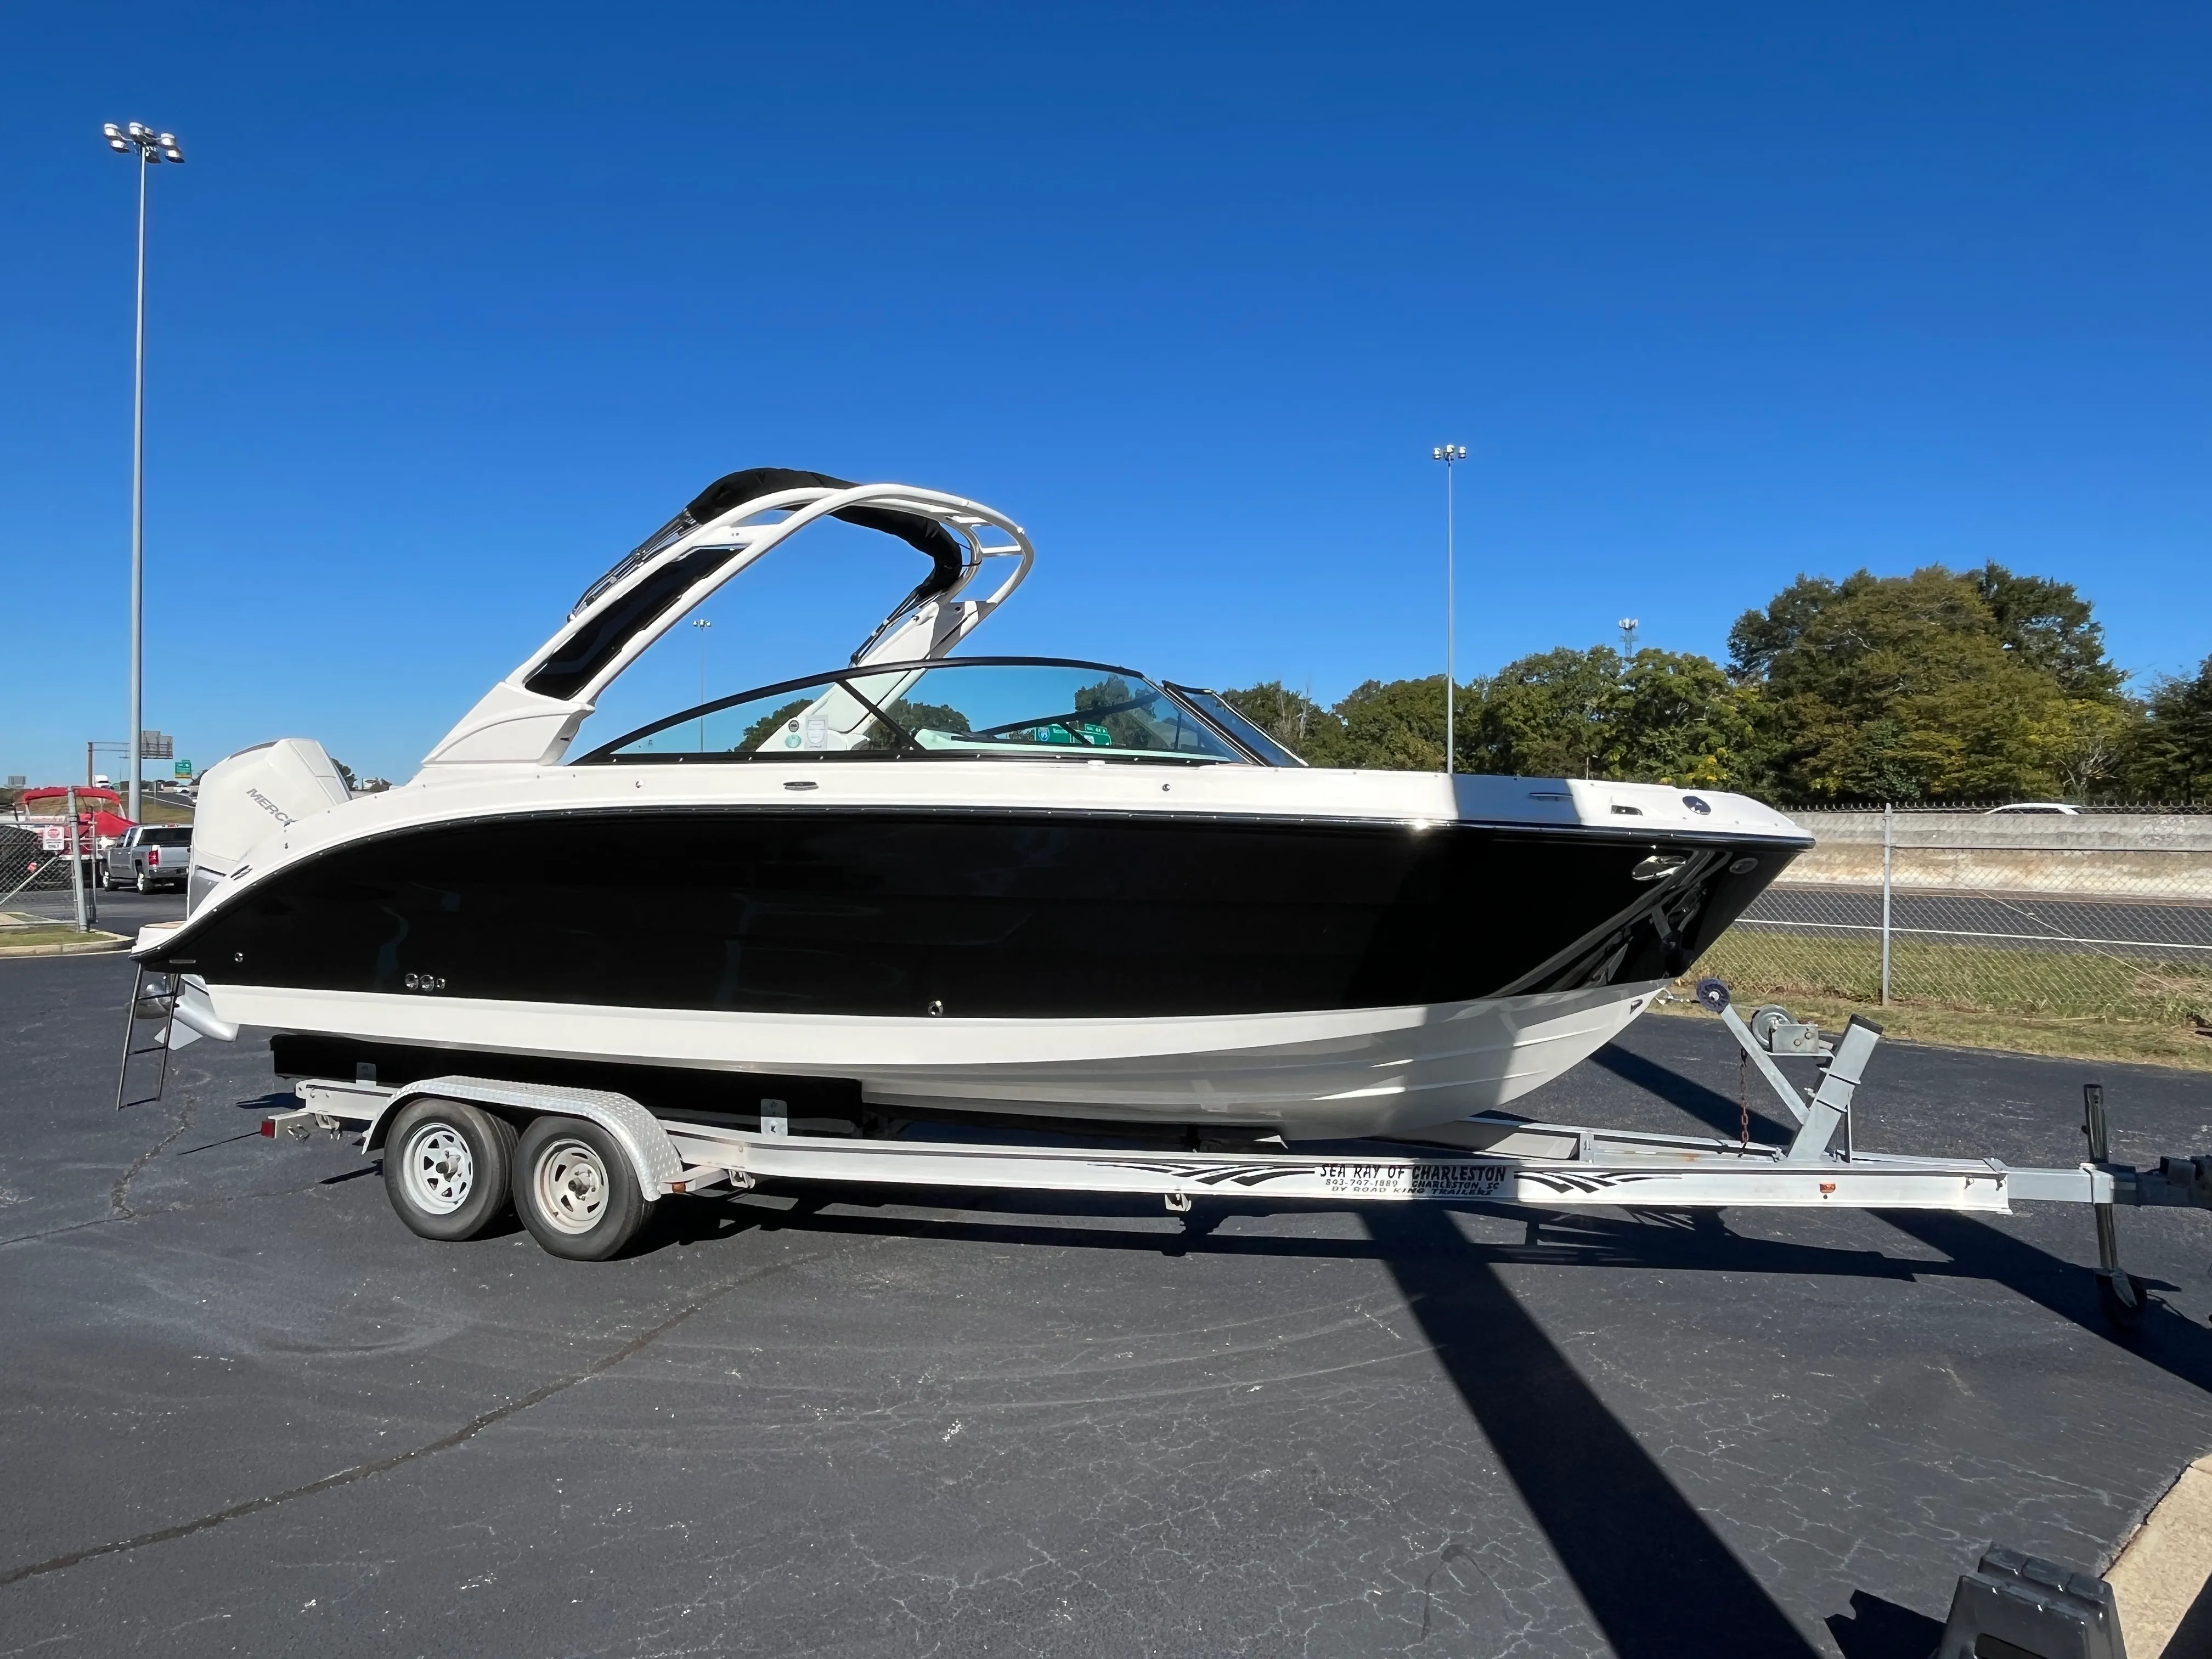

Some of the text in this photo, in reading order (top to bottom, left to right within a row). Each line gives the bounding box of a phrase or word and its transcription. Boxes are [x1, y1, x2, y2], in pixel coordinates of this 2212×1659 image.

[1320, 1163, 1506, 1182] SEA RAY OF CHARLESTON
